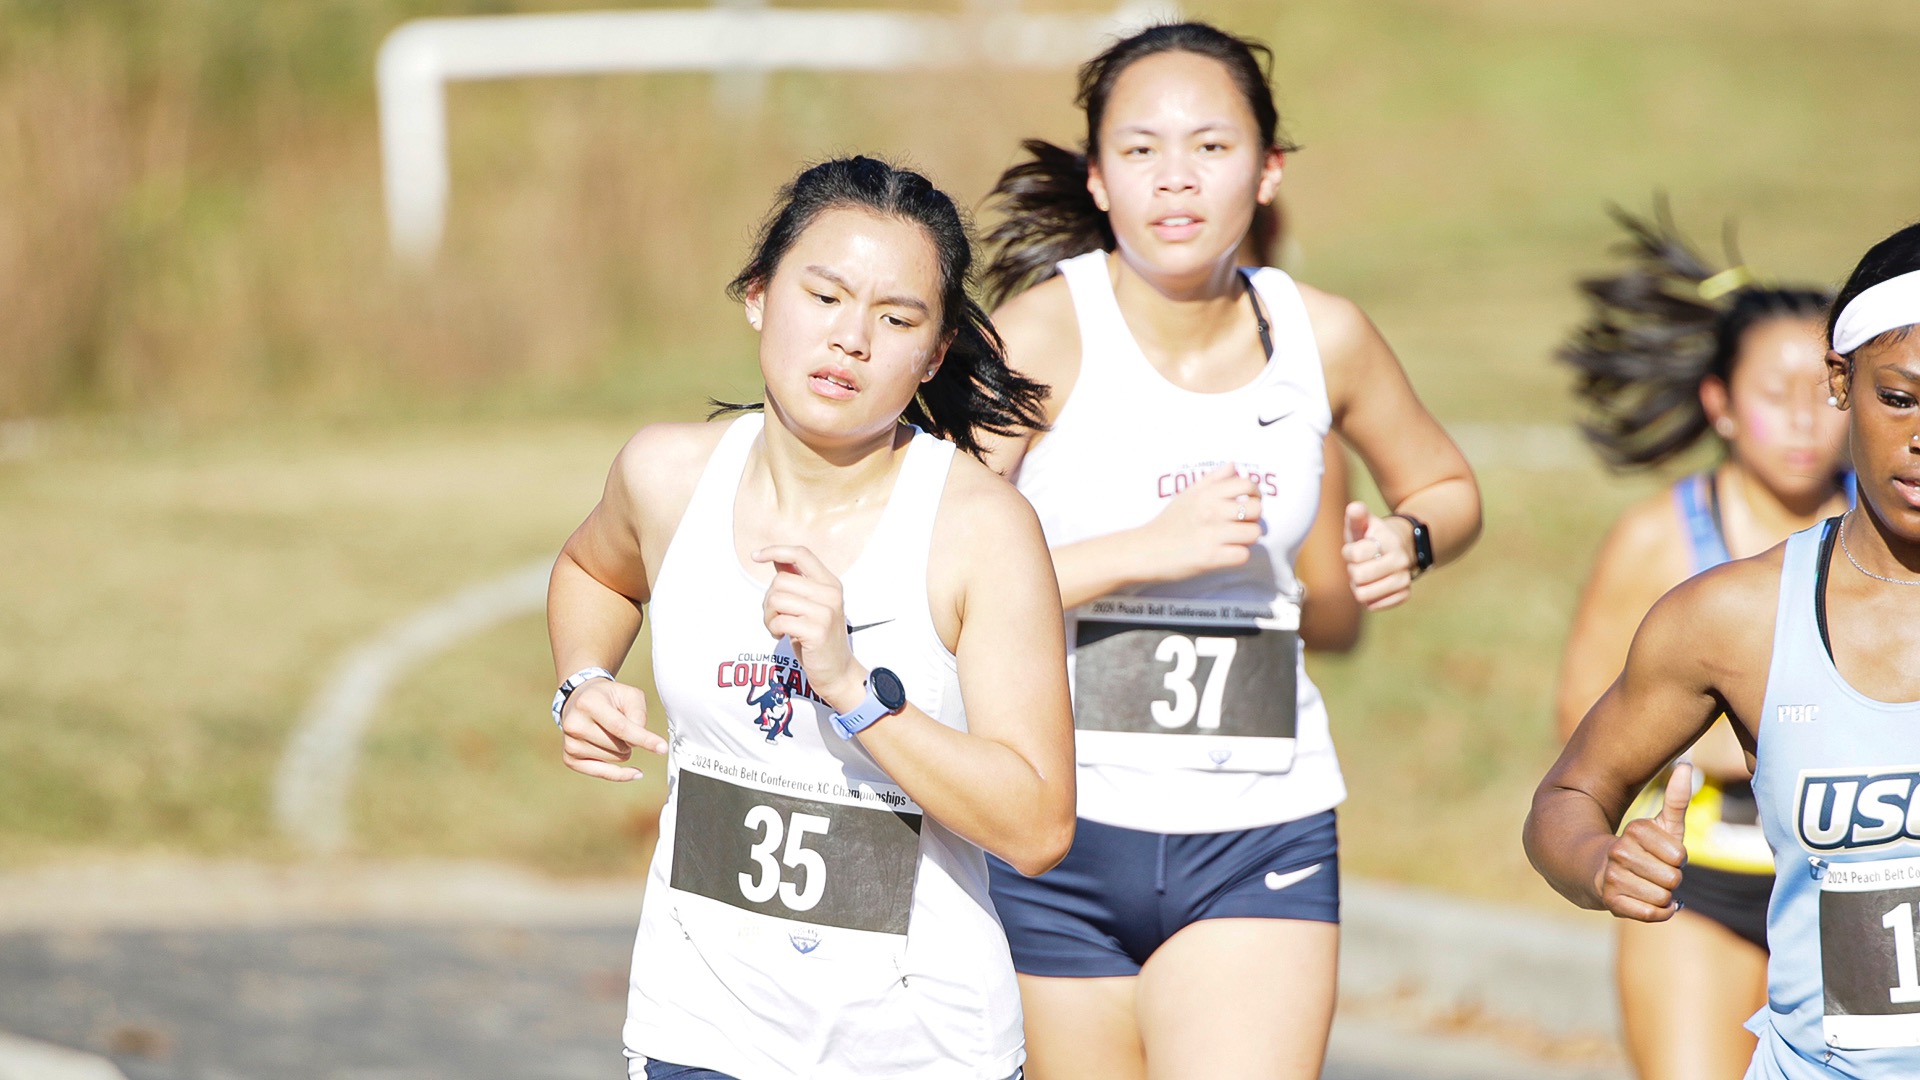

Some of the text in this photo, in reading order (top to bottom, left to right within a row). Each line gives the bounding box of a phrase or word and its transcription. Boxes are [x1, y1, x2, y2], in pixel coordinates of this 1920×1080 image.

[1157, 470, 1278, 498] CORS
[738, 652, 790, 666] COLUMBUS
[1150, 634, 1238, 729] 37
[1777, 704, 1819, 723] PBC
[691, 754, 906, 807] 2024 Peach Belt Conference XC Championships
[737, 804, 831, 912] 35
[1828, 871, 1848, 884] 2024
[1851, 871, 1881, 883] Peach
[1884, 868, 1905, 881] Belt
[1881, 901, 1920, 1004] 1
